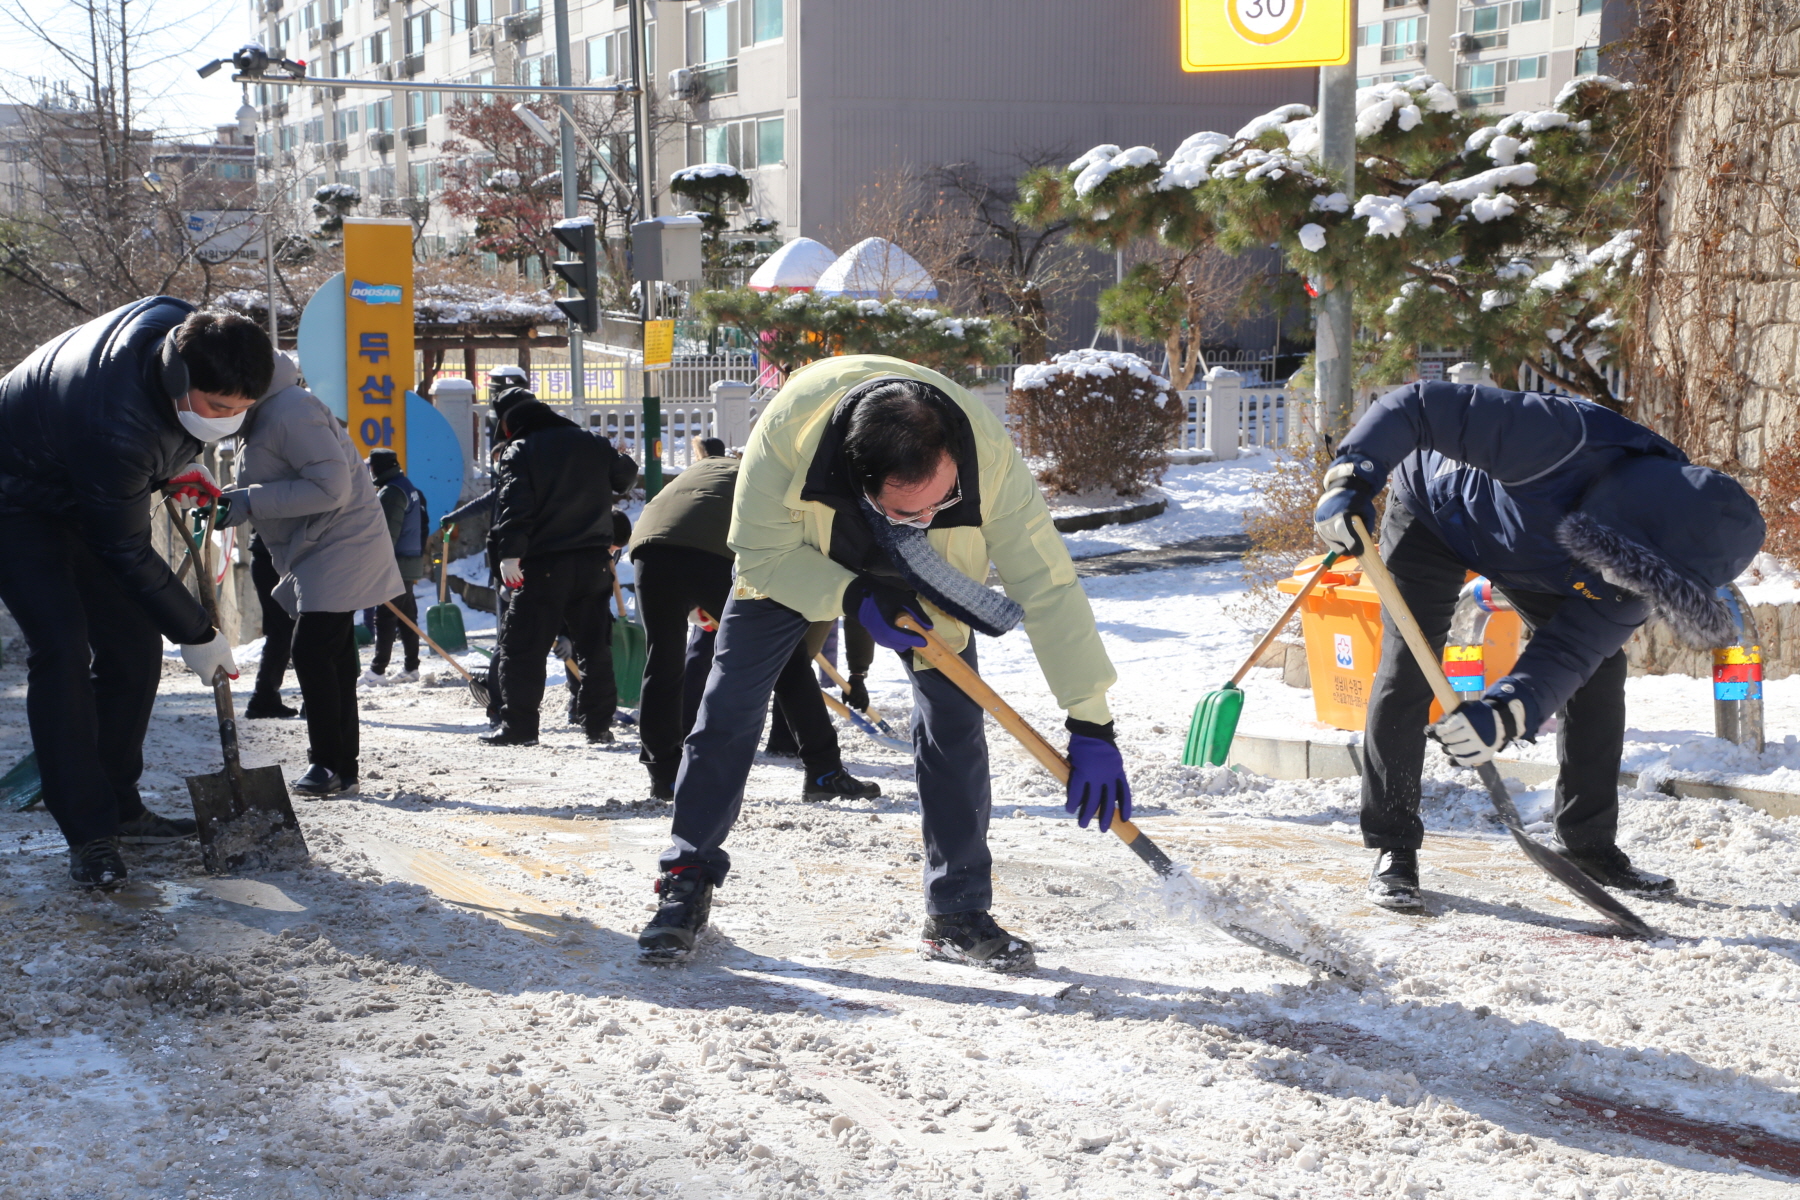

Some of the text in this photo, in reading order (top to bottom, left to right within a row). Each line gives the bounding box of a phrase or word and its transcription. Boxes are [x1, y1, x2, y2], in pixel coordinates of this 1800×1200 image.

[1245, 0, 1286, 18] 30
[351, 288, 400, 297] DOOSAN
[1334, 675, 1349, 692] 성남시
